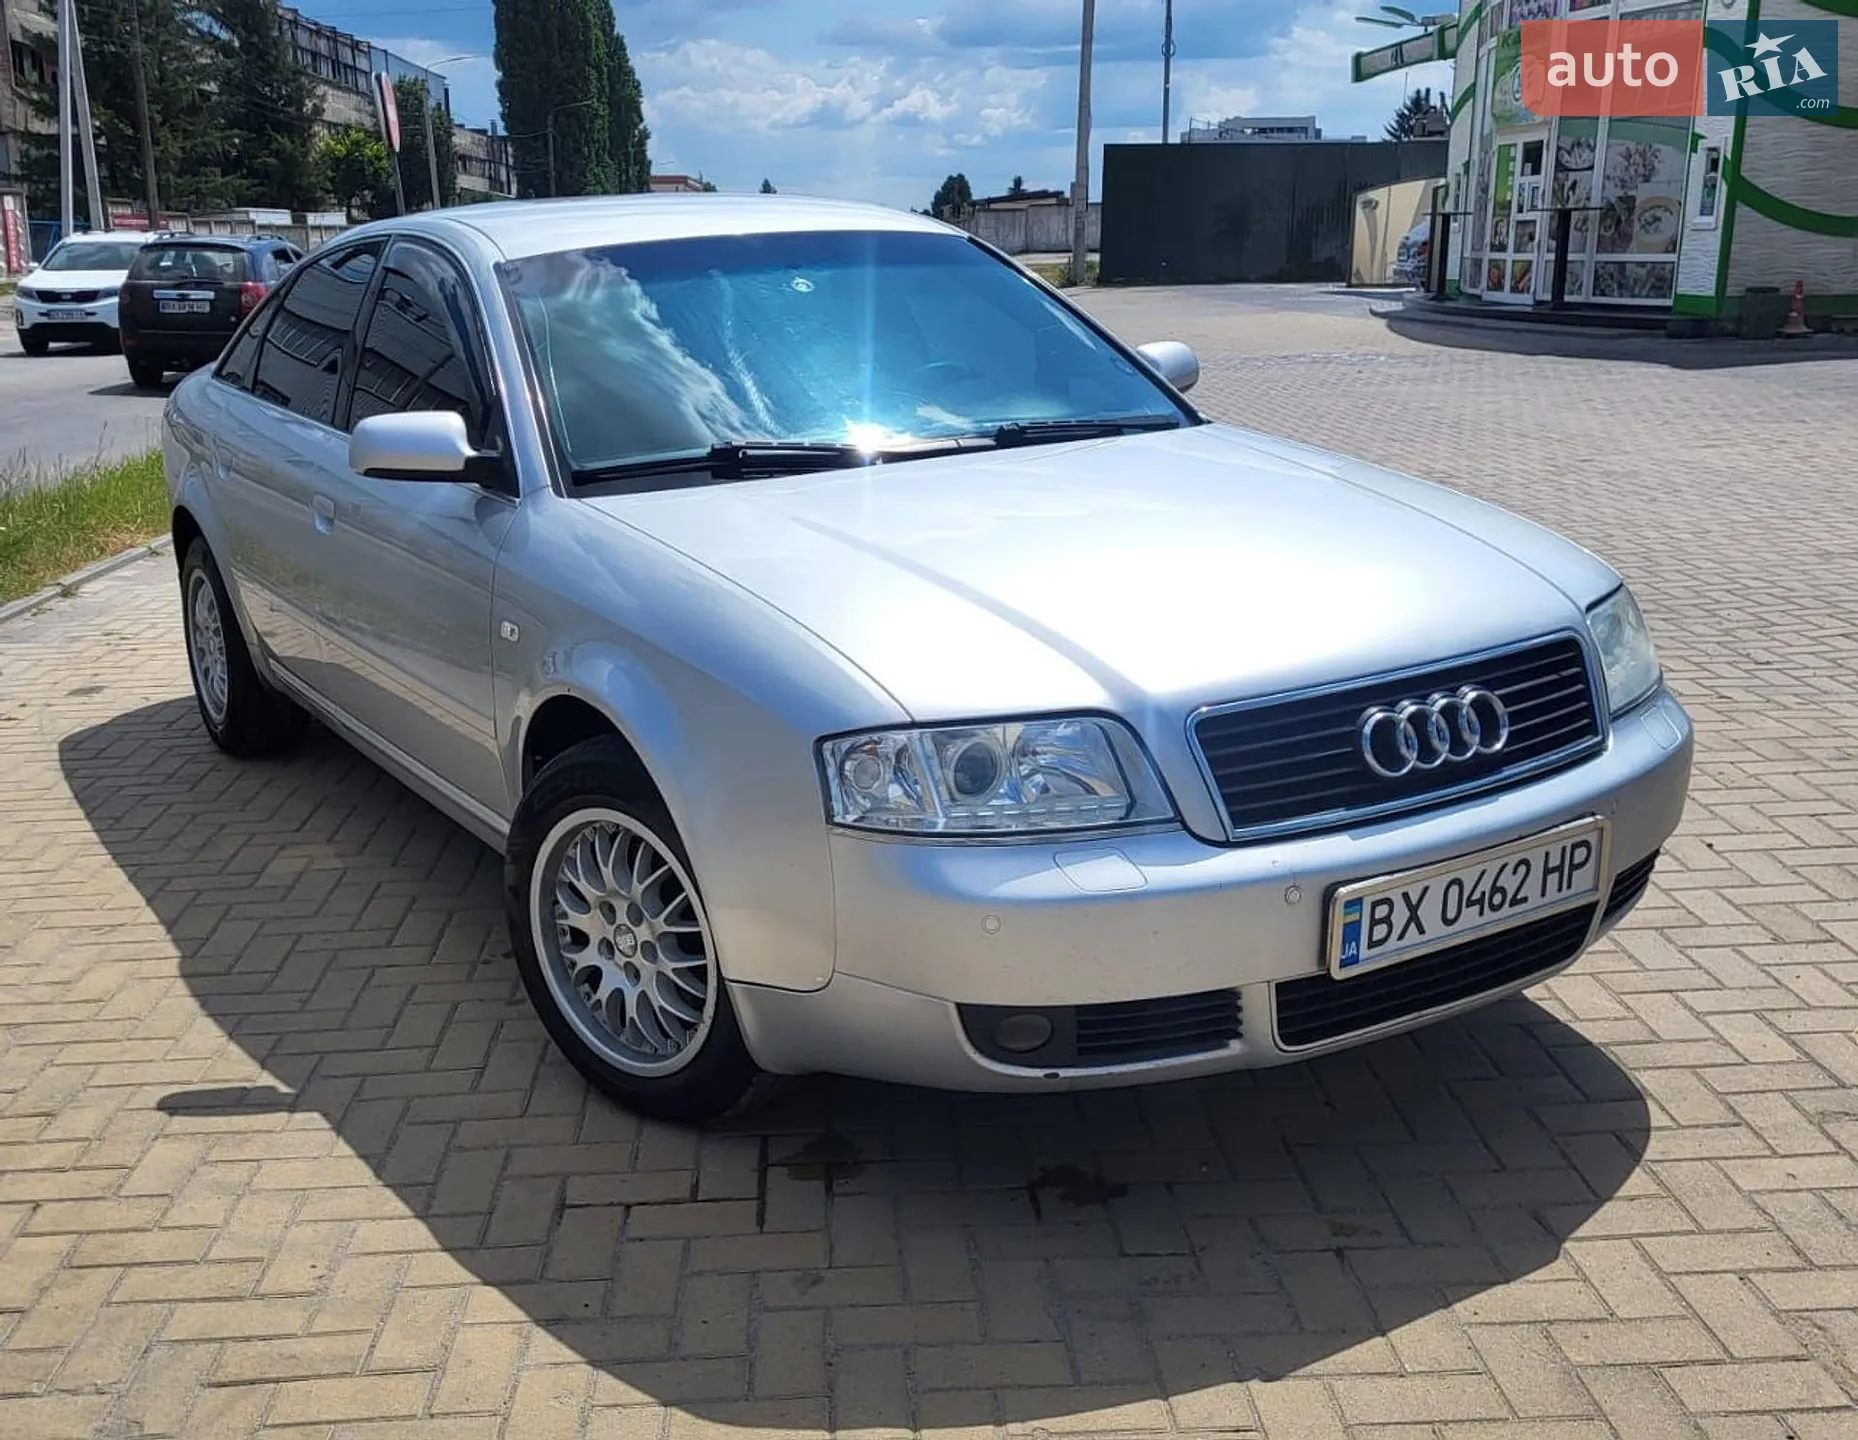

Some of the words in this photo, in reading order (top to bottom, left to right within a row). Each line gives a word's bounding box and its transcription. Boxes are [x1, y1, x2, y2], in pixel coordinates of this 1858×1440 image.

[1367, 884, 1430, 951] BX
[1440, 858, 1533, 927] 0462
[1540, 839, 1592, 898] HP
